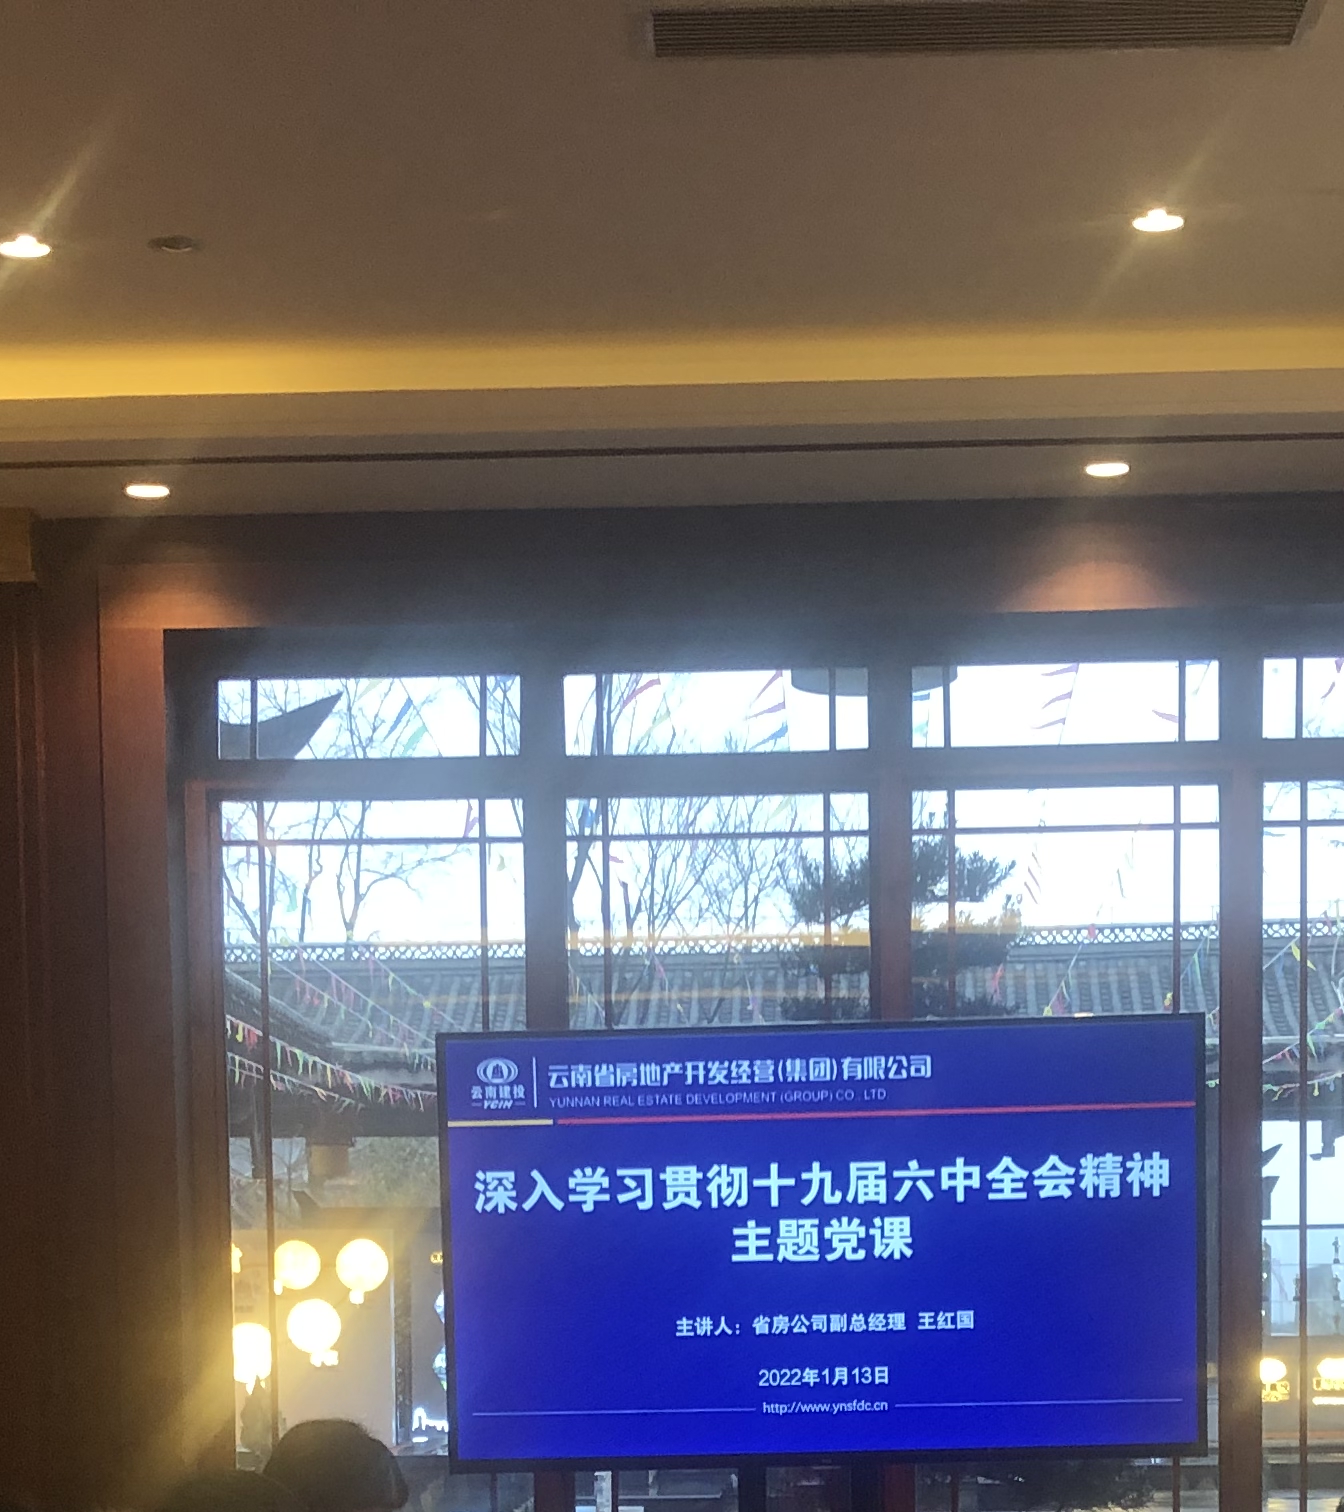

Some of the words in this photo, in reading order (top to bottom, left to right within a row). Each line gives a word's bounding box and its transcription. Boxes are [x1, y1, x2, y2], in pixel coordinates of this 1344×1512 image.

[471, 1084, 526, 1100] 云南建投
[549, 1096, 600, 1108] YUNNAN
[604, 1095, 635, 1107] REAL
[638, 1094, 682, 1106] ESTATE
[686, 1092, 776, 1105] DEVELOPMENT
[780, 1090, 833, 1104] (GROUP)
[473, 1150, 1172, 1214] 深入学习贯彻十九届六中全会精神
[731, 1215, 915, 1263] 主题党课
[917, 1310, 975, 1331] 王红国
[758, 1366, 890, 1387] 2022年1月13日
[762, 1399, 889, 1415] http://www.ynsfdc.cn
